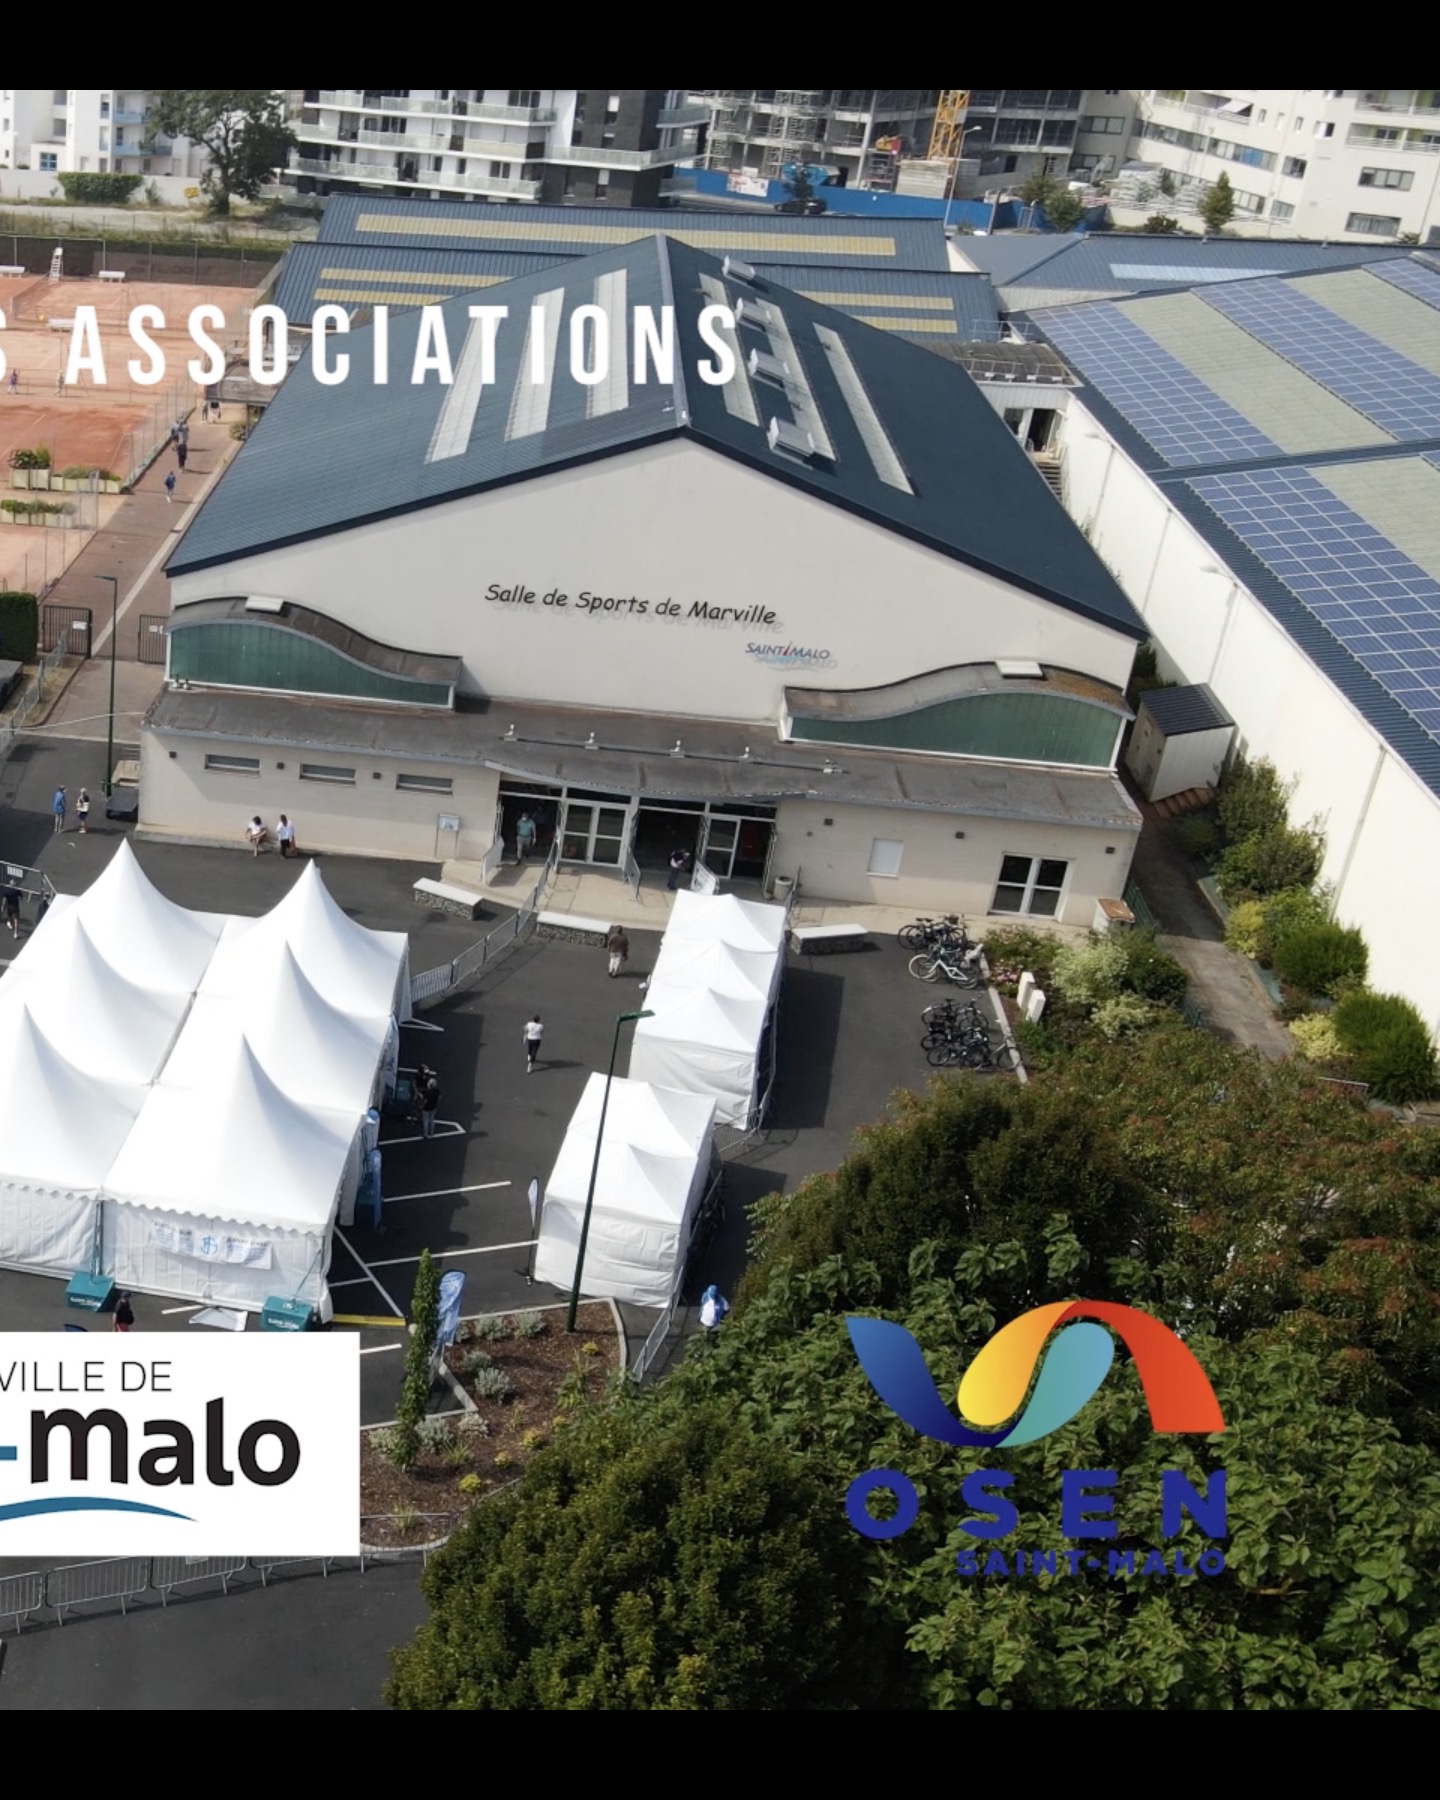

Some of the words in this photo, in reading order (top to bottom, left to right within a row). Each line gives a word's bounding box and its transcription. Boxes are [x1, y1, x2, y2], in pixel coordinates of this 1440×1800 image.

[484, 584, 536, 604] Salle
[542, 588, 568, 607] de
[575, 591, 648, 614] Sports
[655, 598, 681, 617] de
[687, 600, 777, 625] Marville
